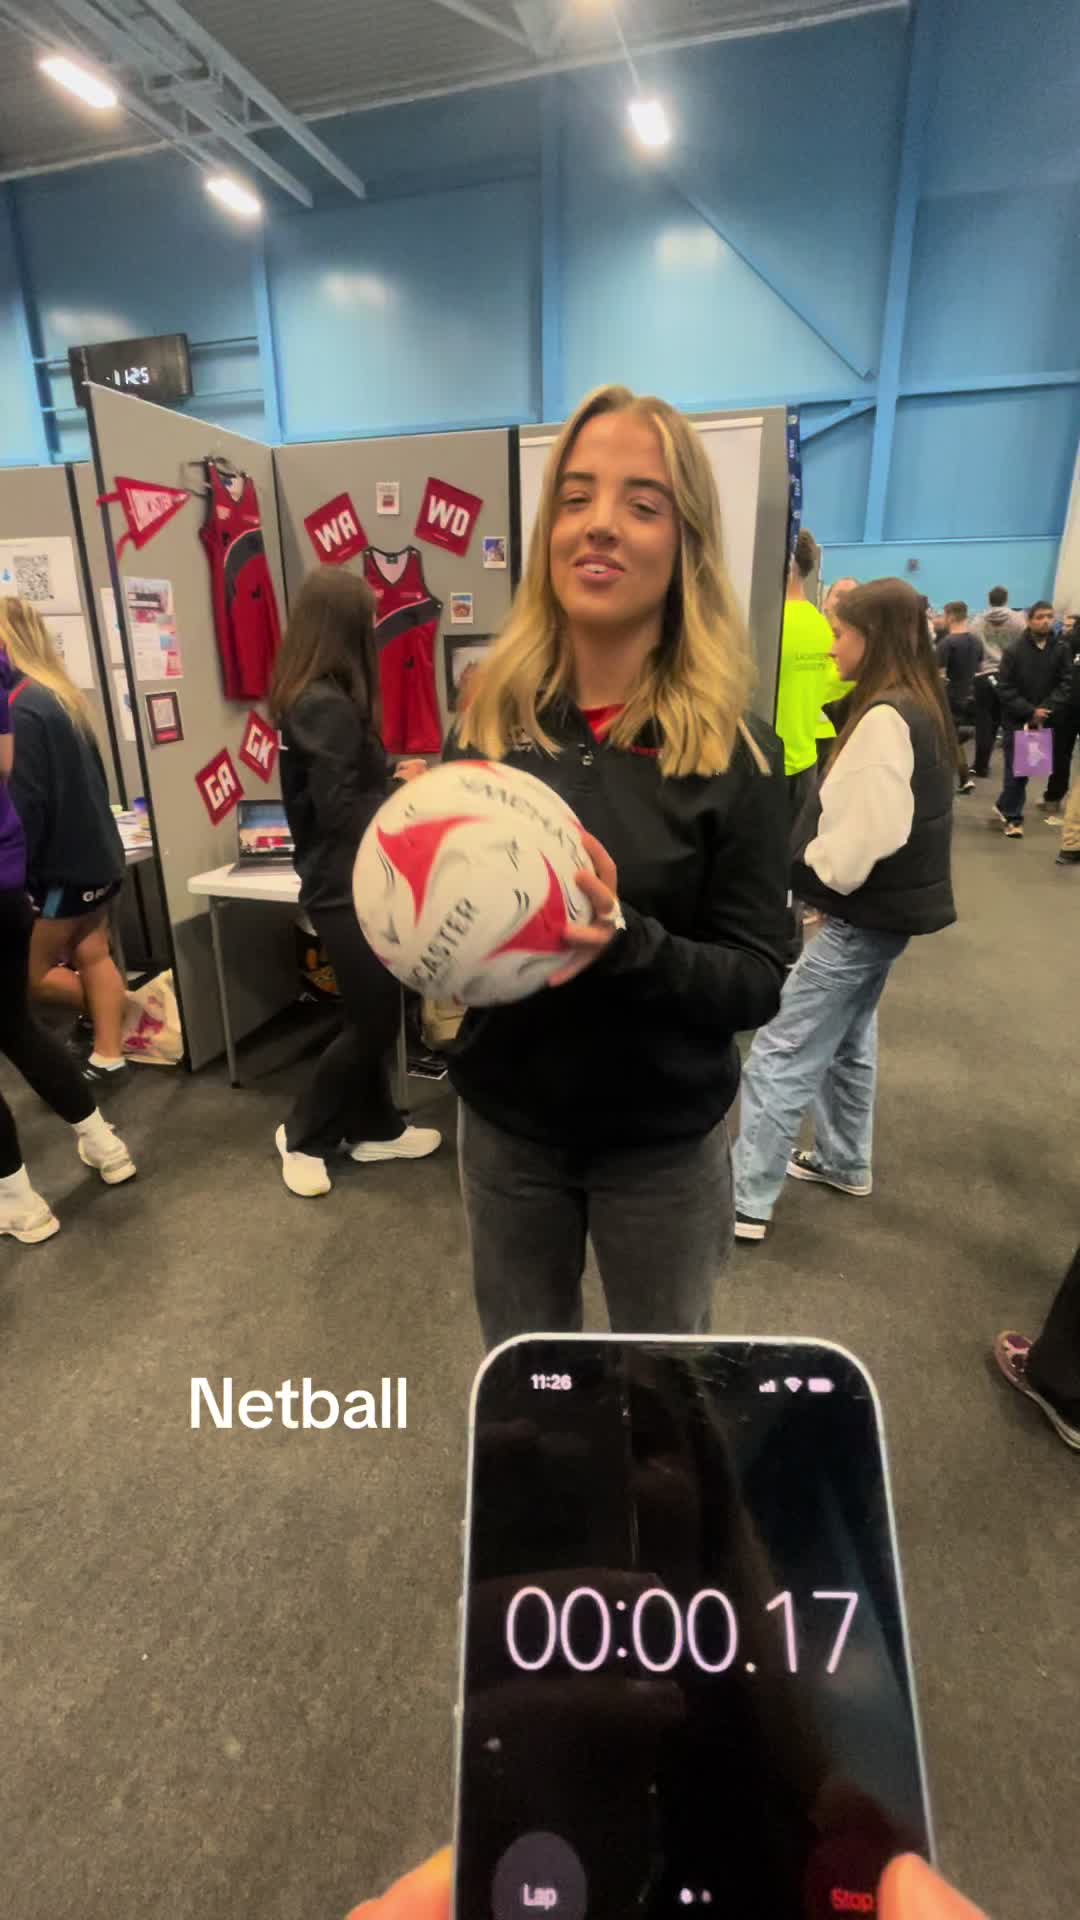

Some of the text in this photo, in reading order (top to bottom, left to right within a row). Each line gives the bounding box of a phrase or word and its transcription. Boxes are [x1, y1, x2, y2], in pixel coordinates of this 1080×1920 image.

[314, 509, 359, 553] WA
[426, 494, 471, 538] WD
[245, 723, 275, 769] GK
[203, 760, 236, 811] GA
[531, 1373, 573, 1391] 11:26
[506, 1586, 860, 1674] 00:00.17
[523, 1884, 558, 1910] Lap
[831, 1887, 874, 1912] Stop
